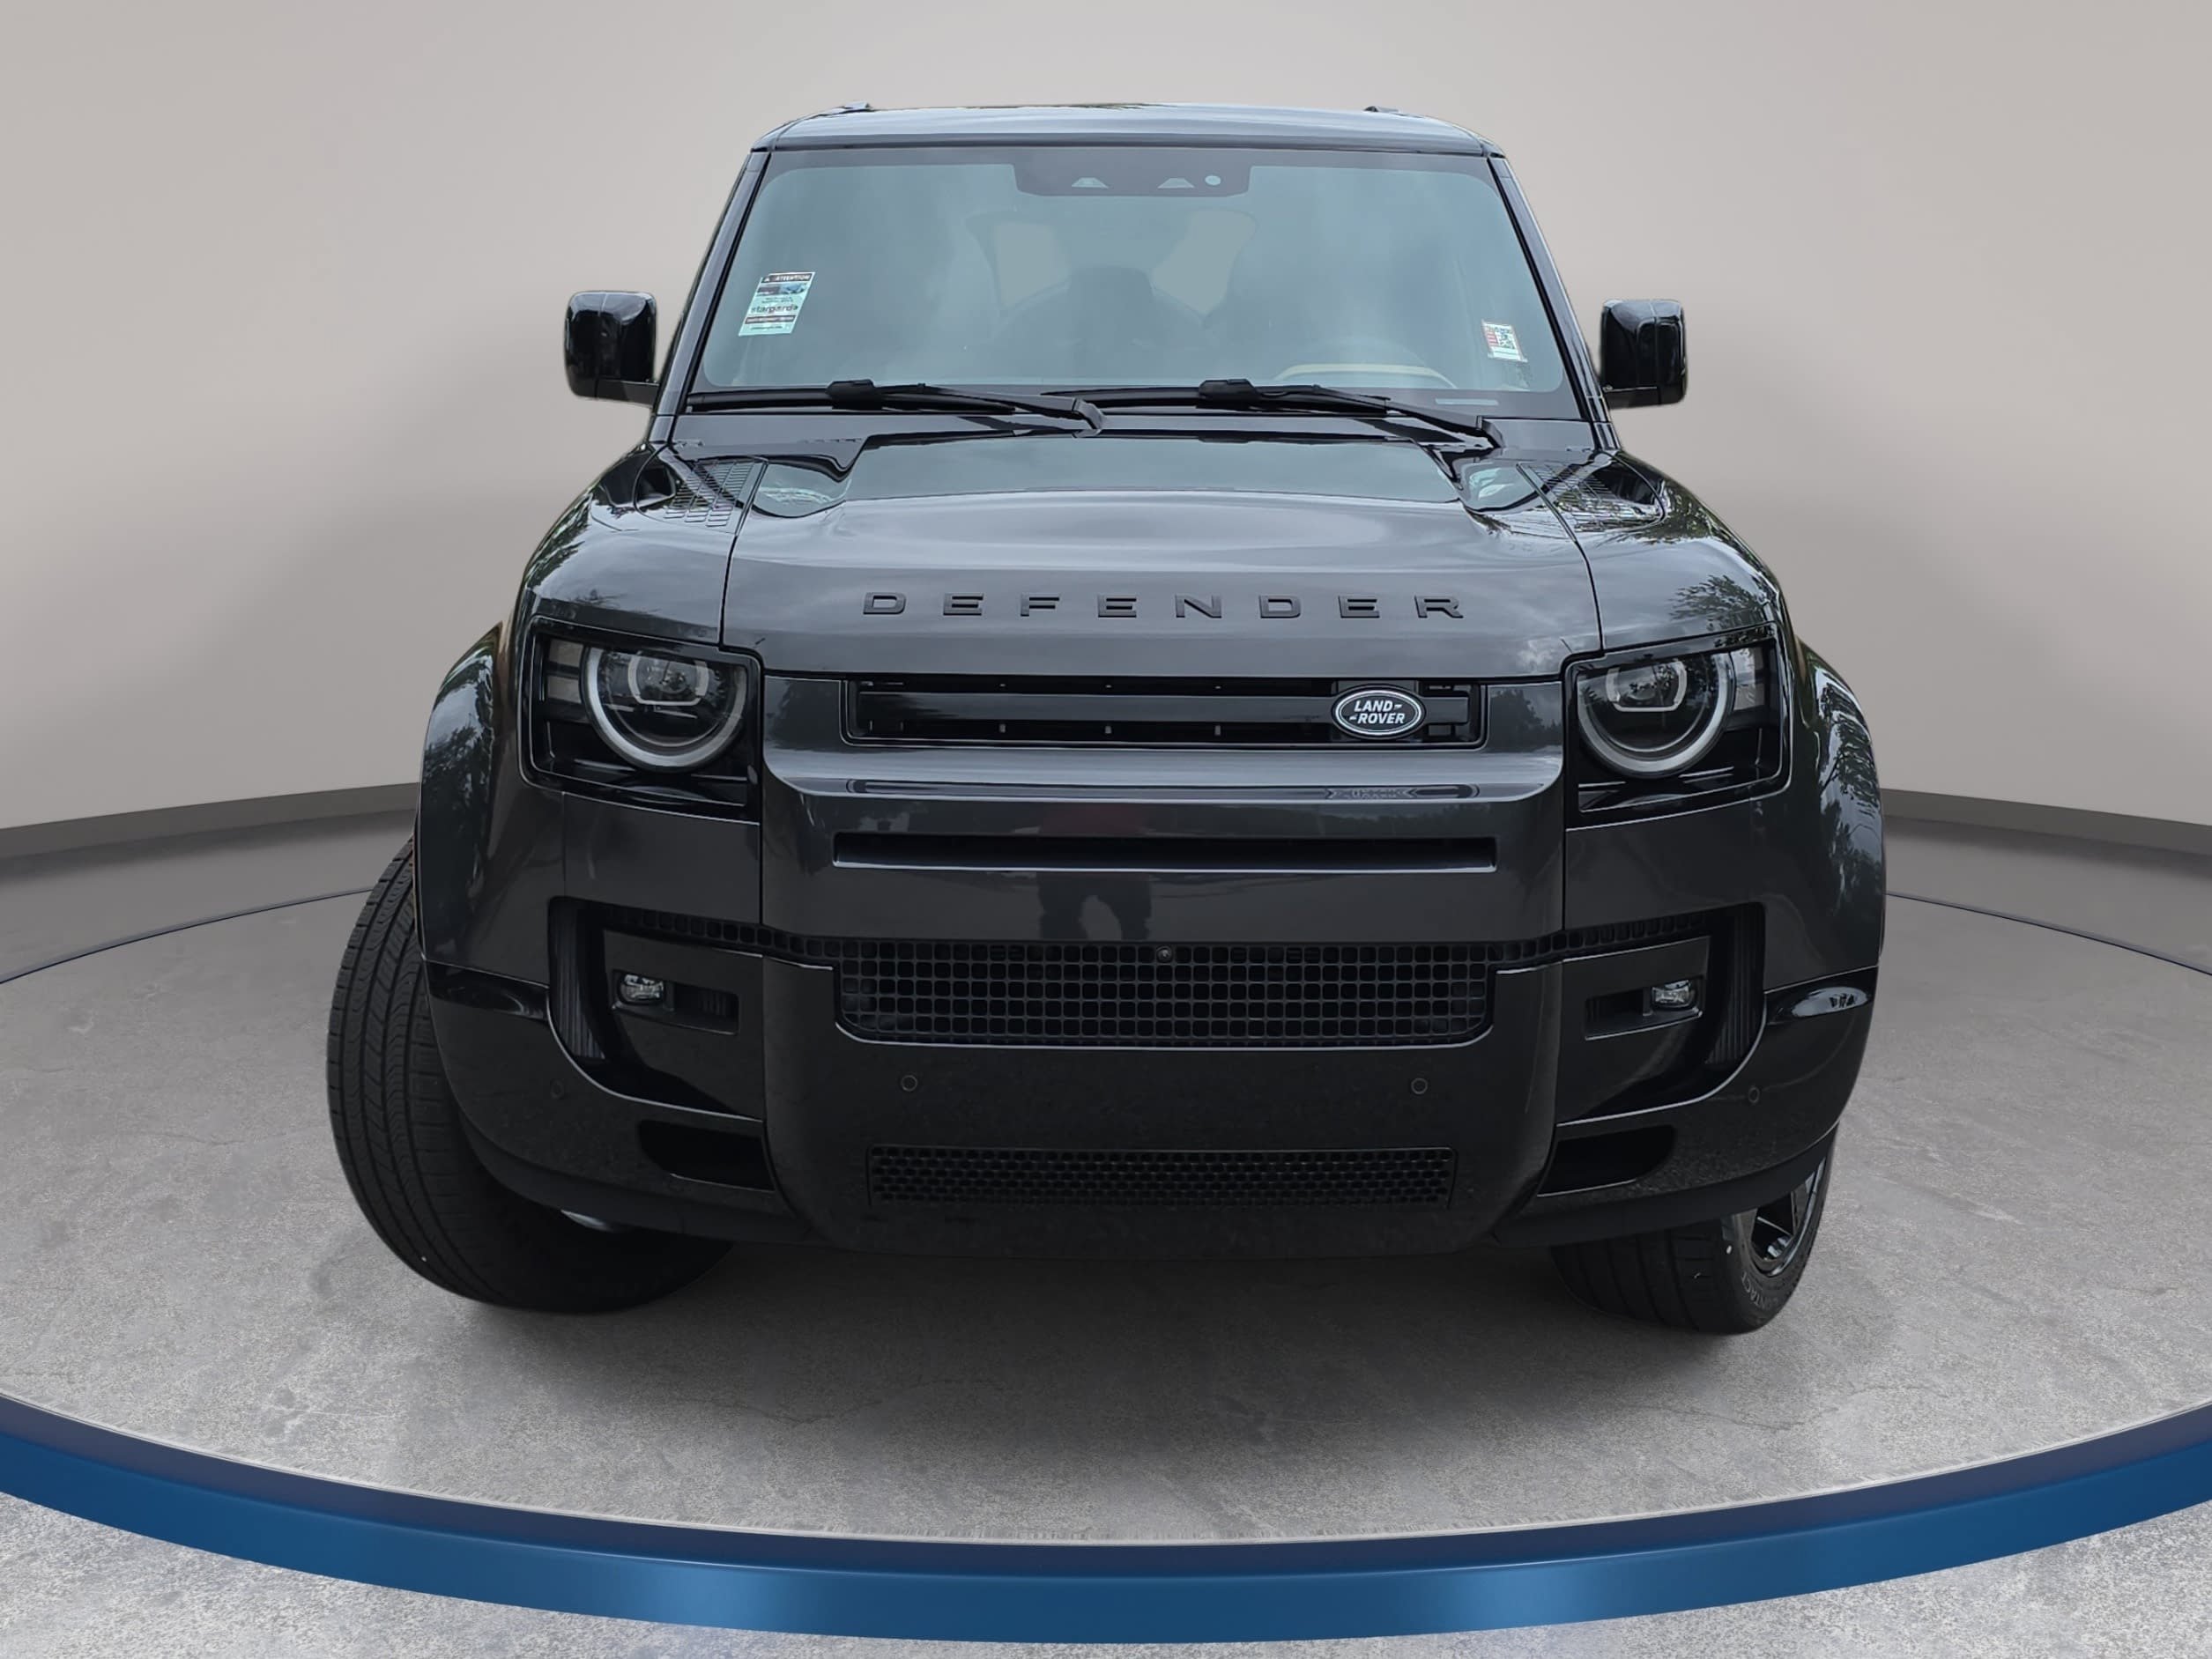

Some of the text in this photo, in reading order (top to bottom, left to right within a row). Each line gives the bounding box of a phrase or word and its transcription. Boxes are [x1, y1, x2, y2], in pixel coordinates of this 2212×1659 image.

[863, 593, 1464, 618] DEFENDER
[1354, 700, 1393, 712] LAND
[1357, 713, 1405, 724] ROVER
